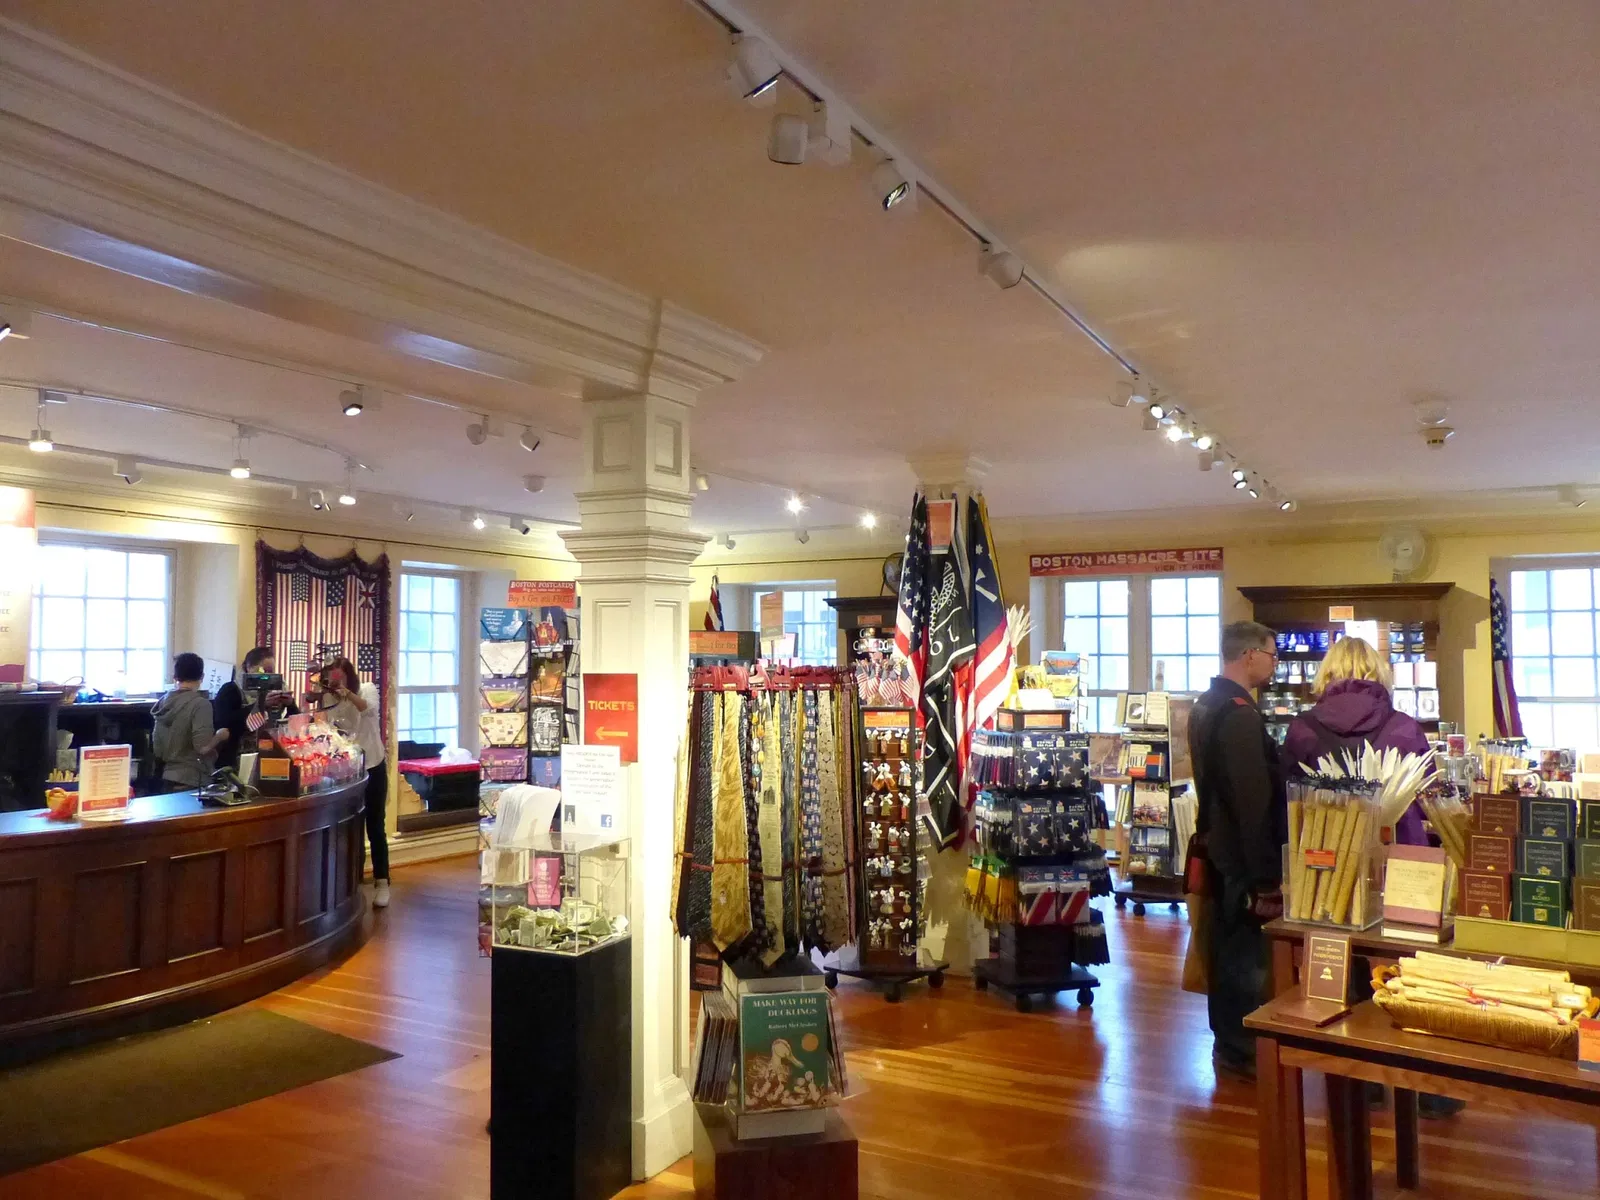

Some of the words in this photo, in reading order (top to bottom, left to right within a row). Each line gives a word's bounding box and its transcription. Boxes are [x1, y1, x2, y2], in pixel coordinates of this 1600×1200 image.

[1031, 555, 1092, 568] BOSTON
[1097, 551, 1177, 565] MASSACRE
[1182, 550, 1221, 563] SITE
[510, 581, 537, 589] BOSTON
[538, 581, 575, 589] POSTCARDS
[588, 700, 635, 711] TICKETS
[752, 999, 778, 1008] MAKE
[779, 998, 797, 1007] WAY
[799, 997, 817, 1006] FOR
[767, 1008, 818, 1017] DUCKLINGS
